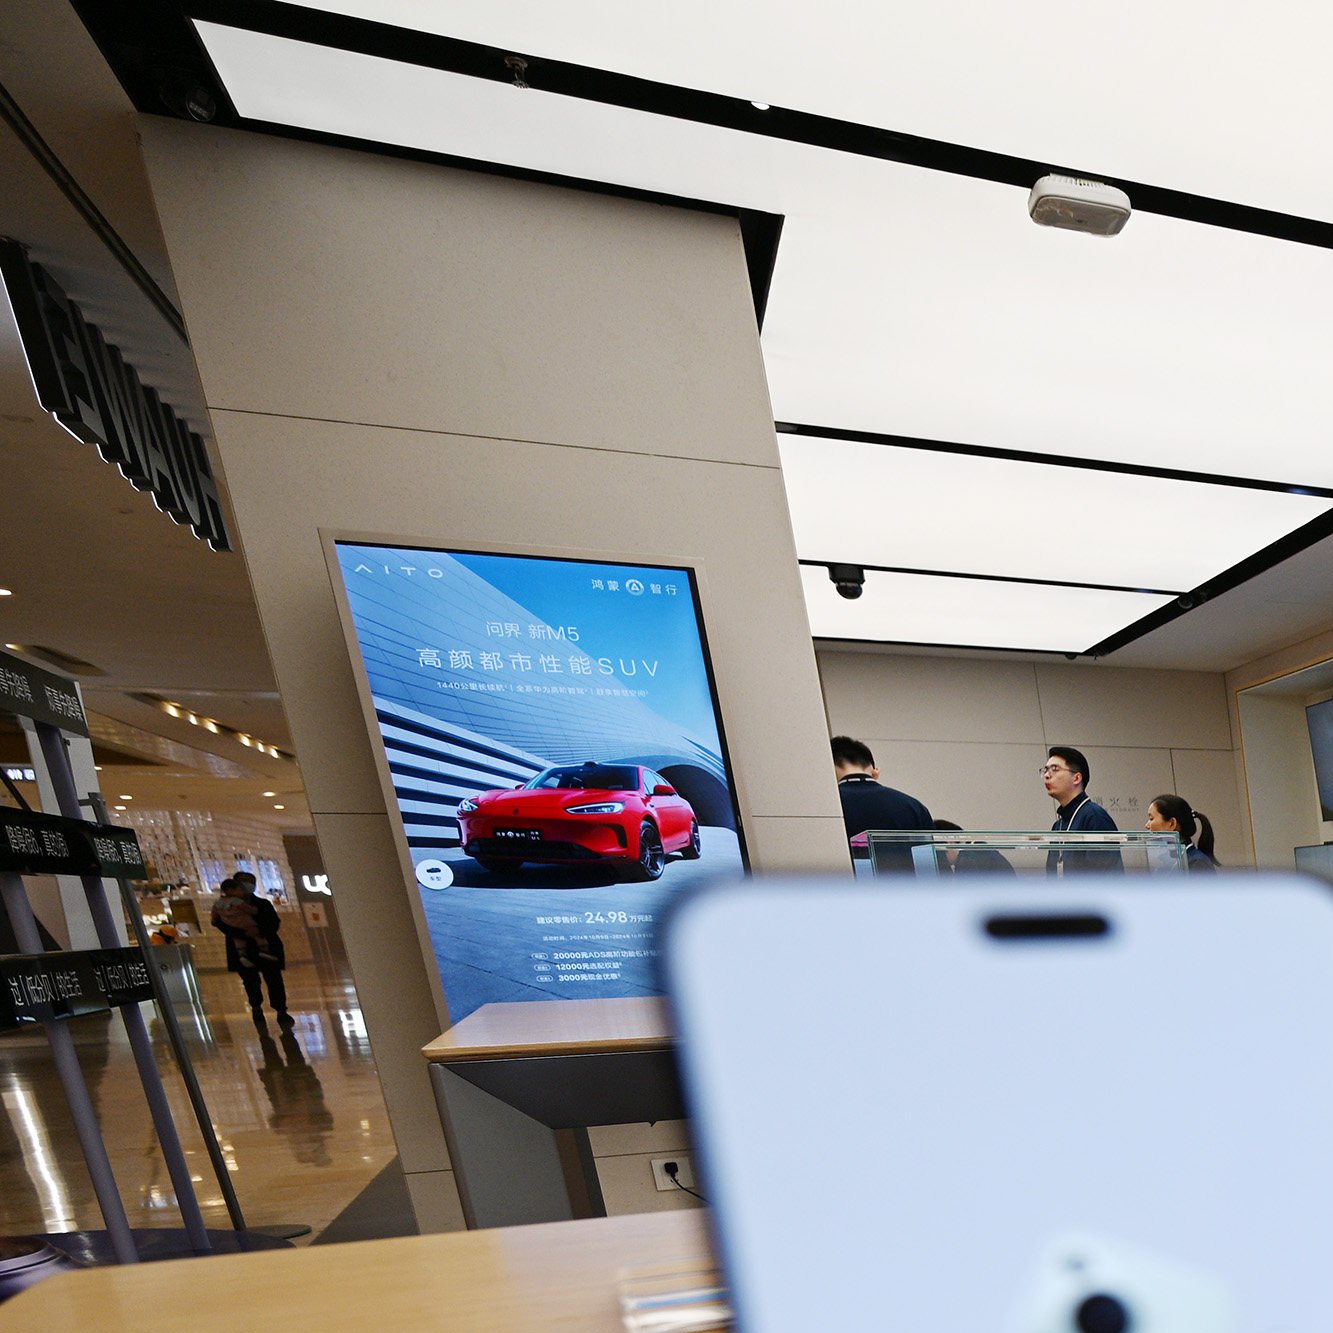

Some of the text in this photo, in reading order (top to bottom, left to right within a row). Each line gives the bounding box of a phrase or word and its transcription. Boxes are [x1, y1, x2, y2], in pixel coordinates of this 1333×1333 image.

[354, 563, 444, 578] AITO
[591, 578, 677, 596] 鸿蒙 智行
[486, 621, 580, 642] 问界 新M5
[416, 648, 658, 677] 高颜都市性能SUV
[584, 911, 627, 925] 24.98
